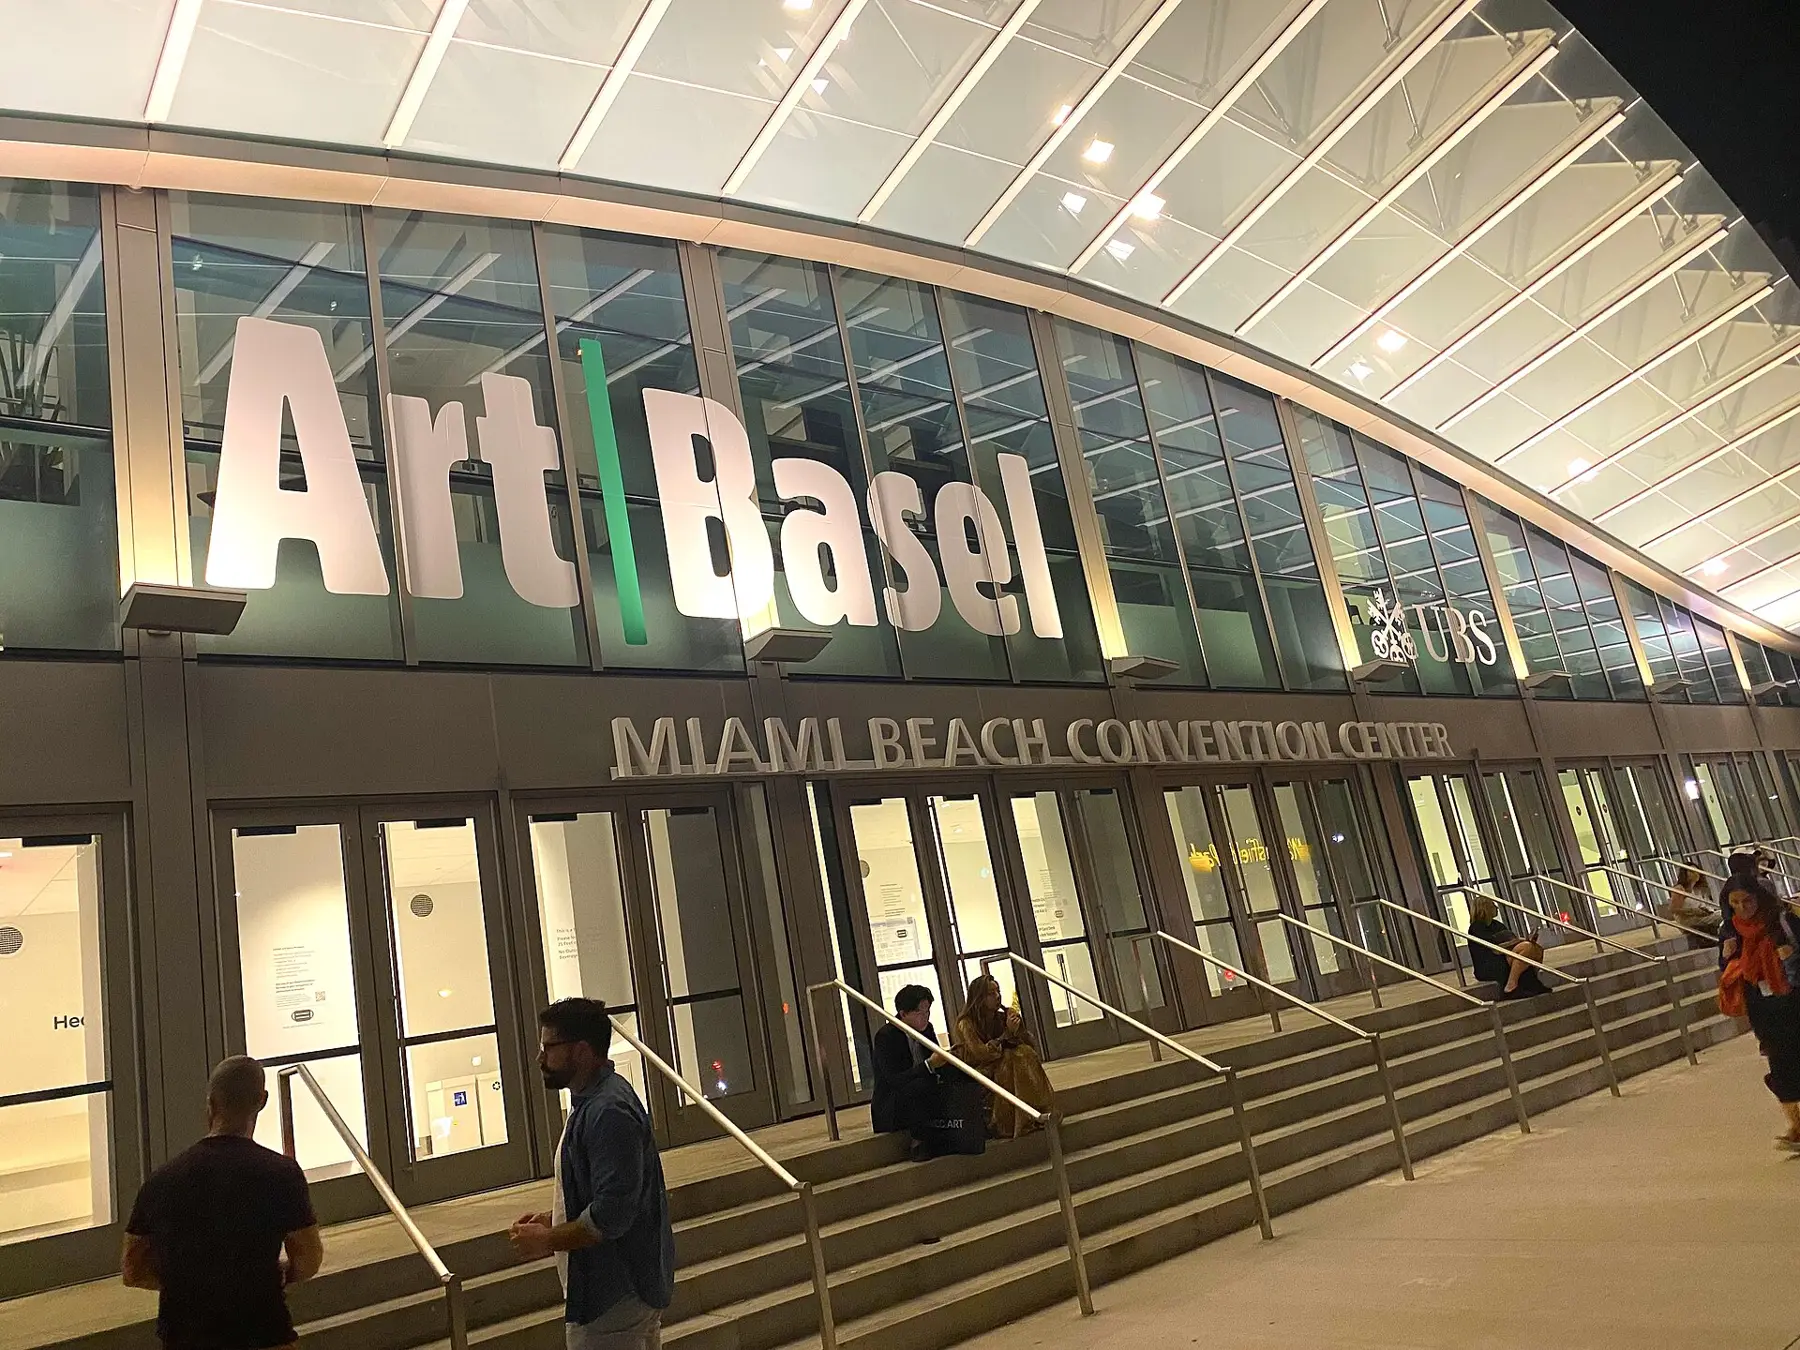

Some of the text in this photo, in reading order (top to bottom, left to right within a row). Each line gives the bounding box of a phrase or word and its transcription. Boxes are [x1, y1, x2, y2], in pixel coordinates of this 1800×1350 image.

[206, 316, 1064, 639] Art Basel
[1412, 603, 1497, 666] UBS
[611, 717, 1457, 776] MIAMI BEACH CONVENTION CENTER
